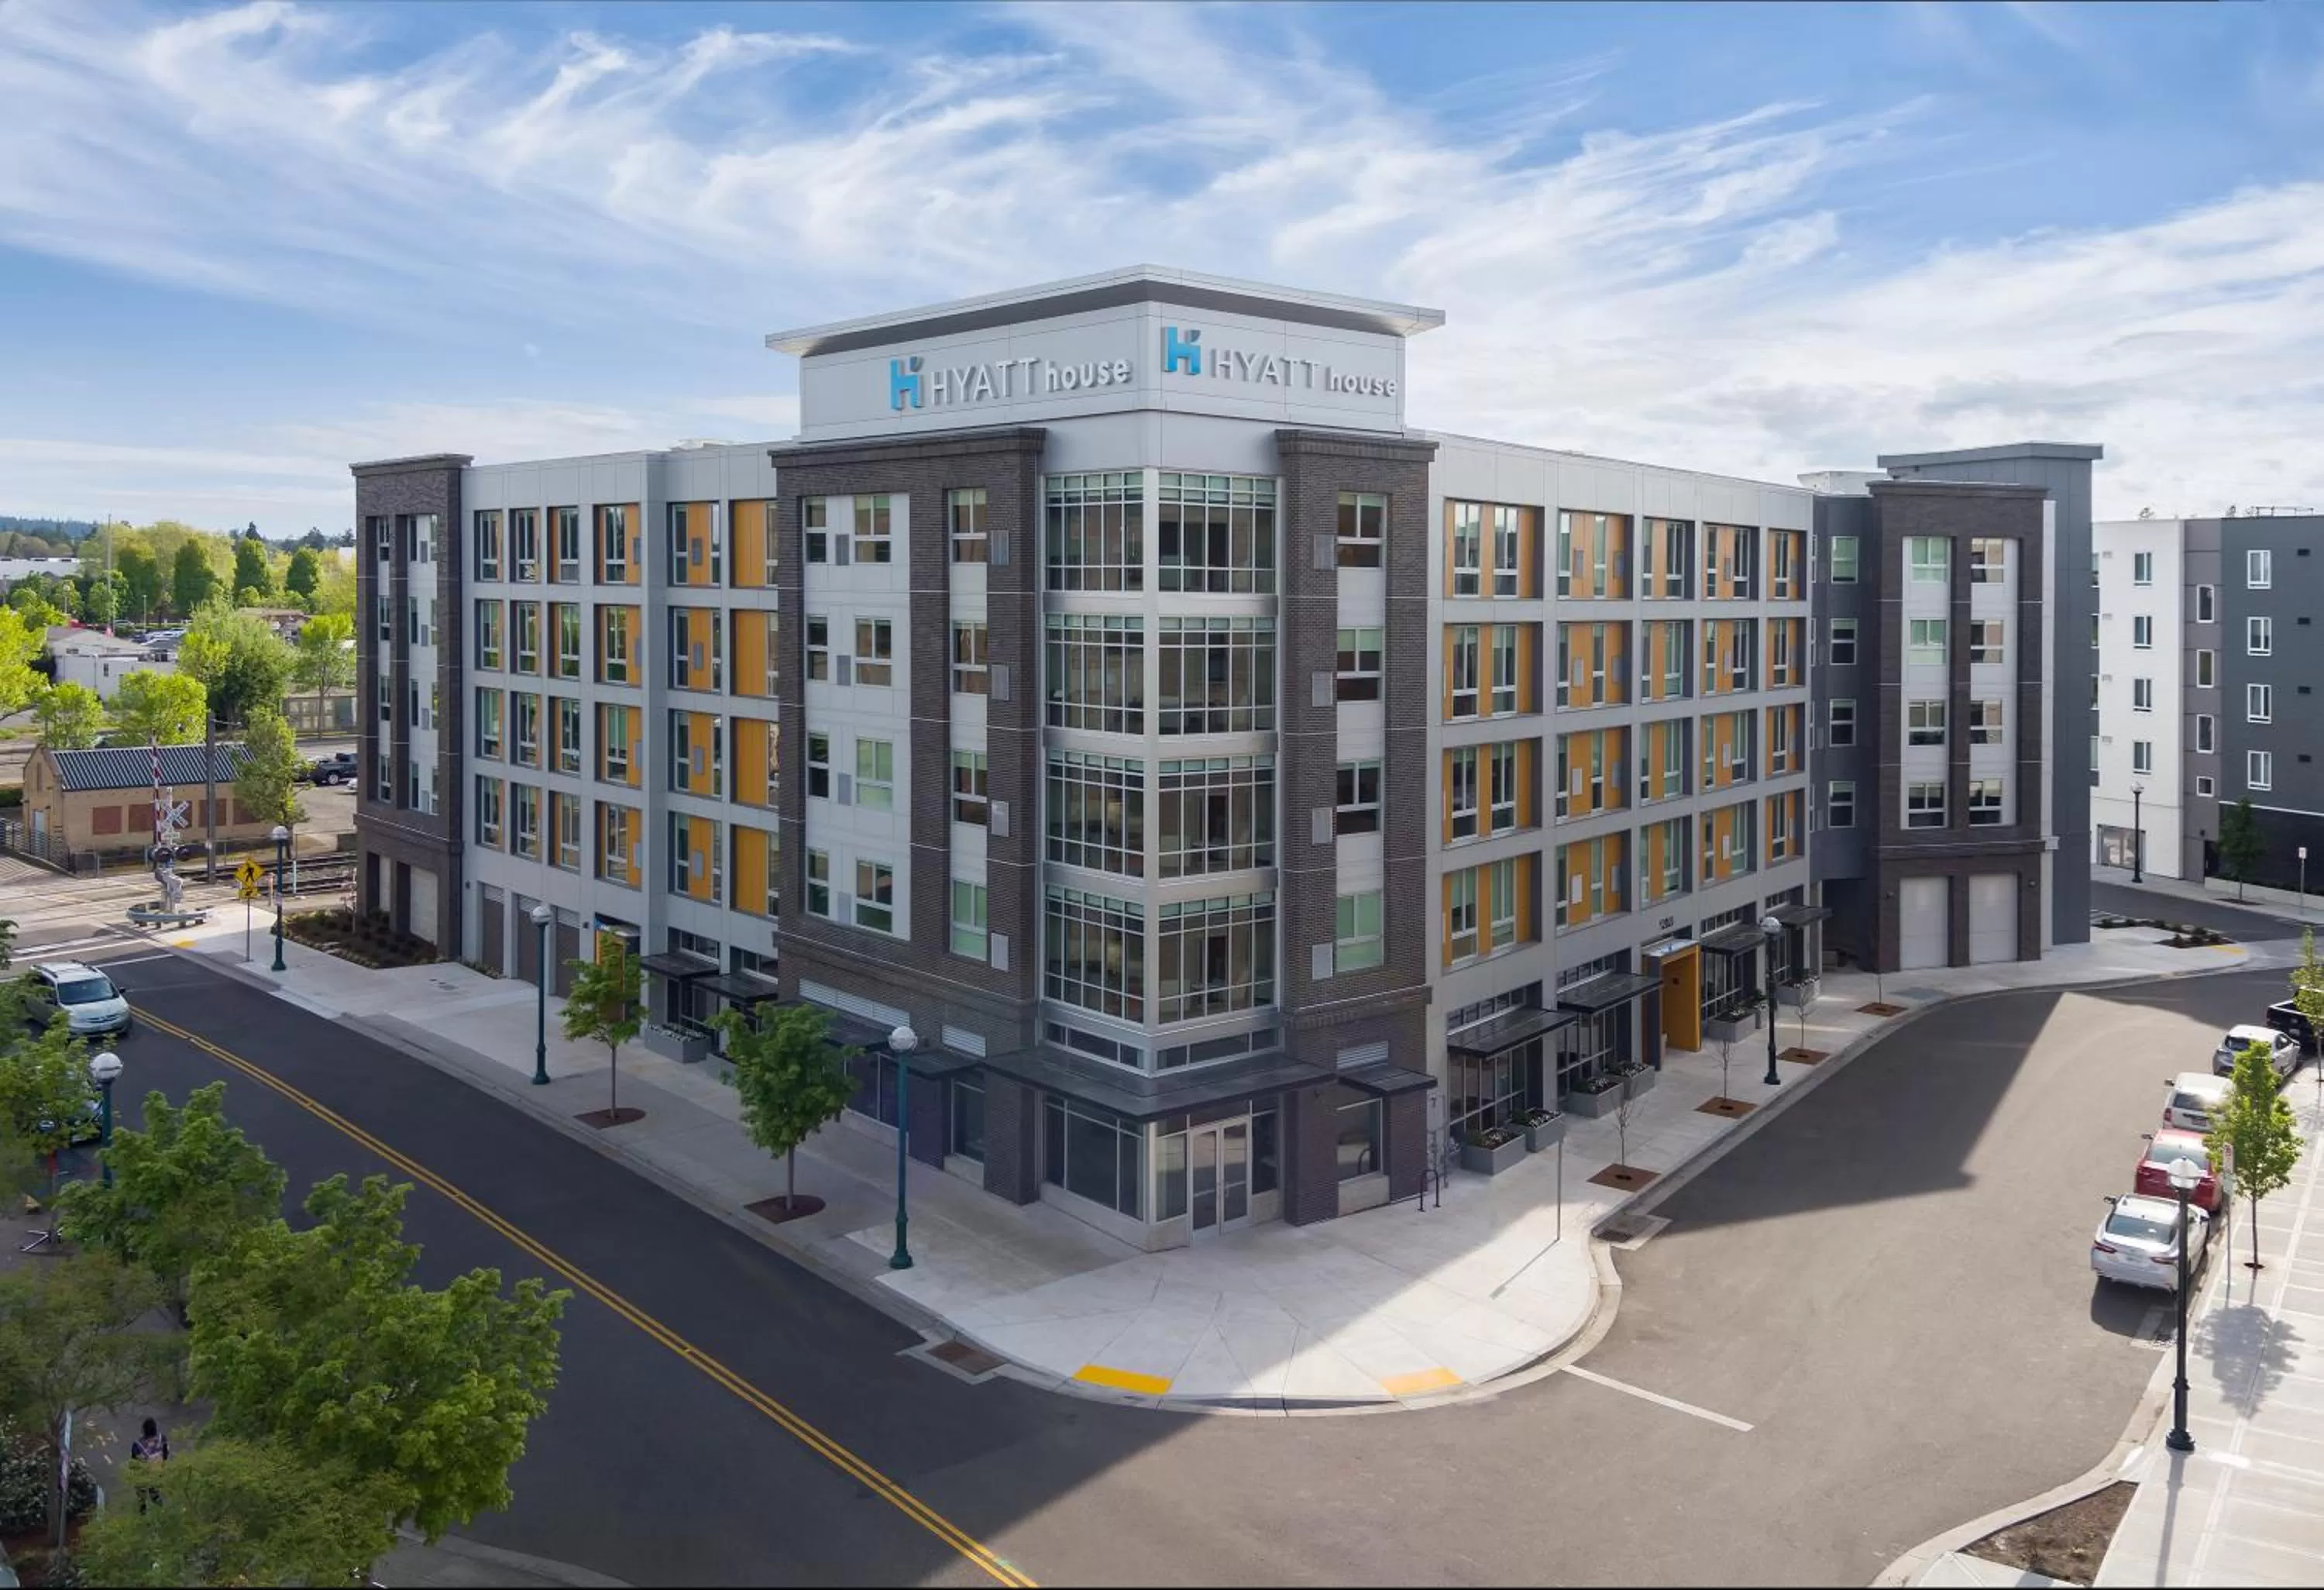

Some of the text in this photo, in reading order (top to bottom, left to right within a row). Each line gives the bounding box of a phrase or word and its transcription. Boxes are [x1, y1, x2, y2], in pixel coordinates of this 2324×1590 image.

[931, 357, 1039, 405] HYATT
[1044, 359, 1132, 392] house
[1212, 349, 1320, 388] HYATT
[1326, 365, 1397, 398] house
